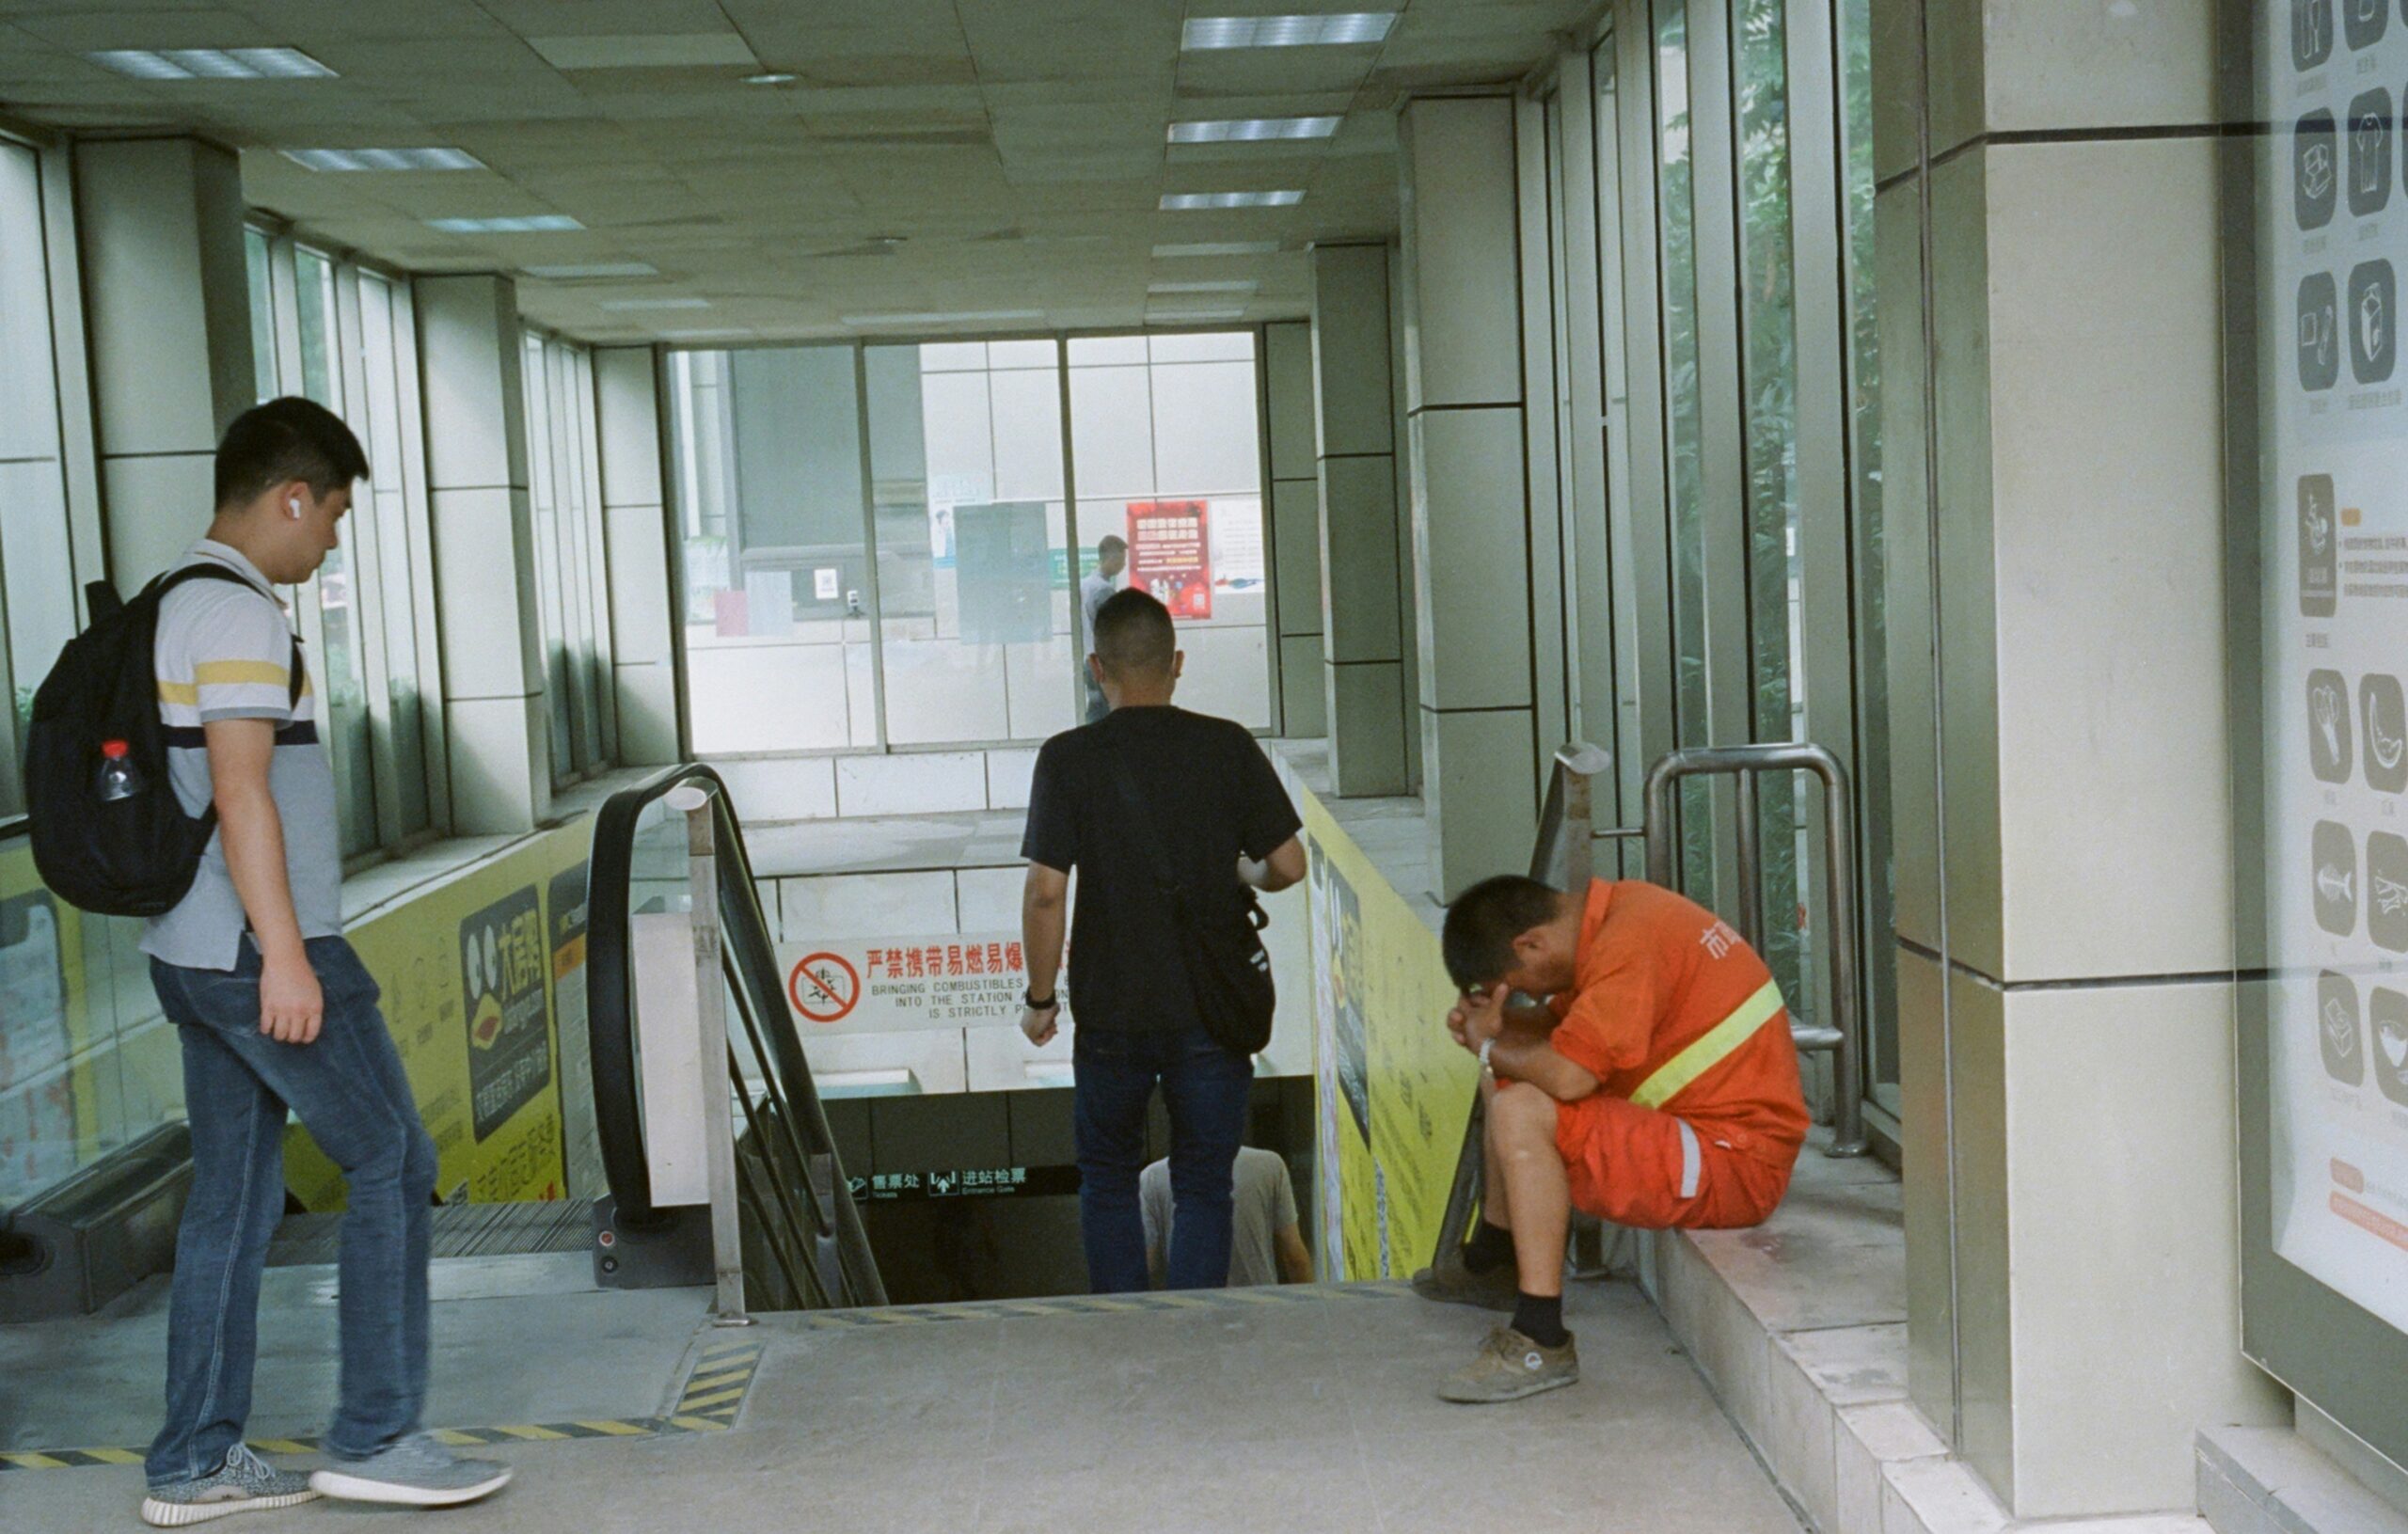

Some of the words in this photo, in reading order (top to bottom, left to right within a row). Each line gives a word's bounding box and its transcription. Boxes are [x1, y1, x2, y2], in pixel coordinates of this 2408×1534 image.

[865, 941, 1069, 979] 严禁携带易燃易爆
[871, 983, 927, 997] BRINGING
[932, 977, 1023, 993] COMBUSTIBLES
[895, 996, 923, 1008] INTO
[931, 995, 953, 1006] THE
[960, 992, 1013, 1004] STATION
[928, 1007, 941, 1019] IS
[947, 1005, 1006, 1019] STRICTLY
[962, 1167, 1027, 1186] 进站检票
